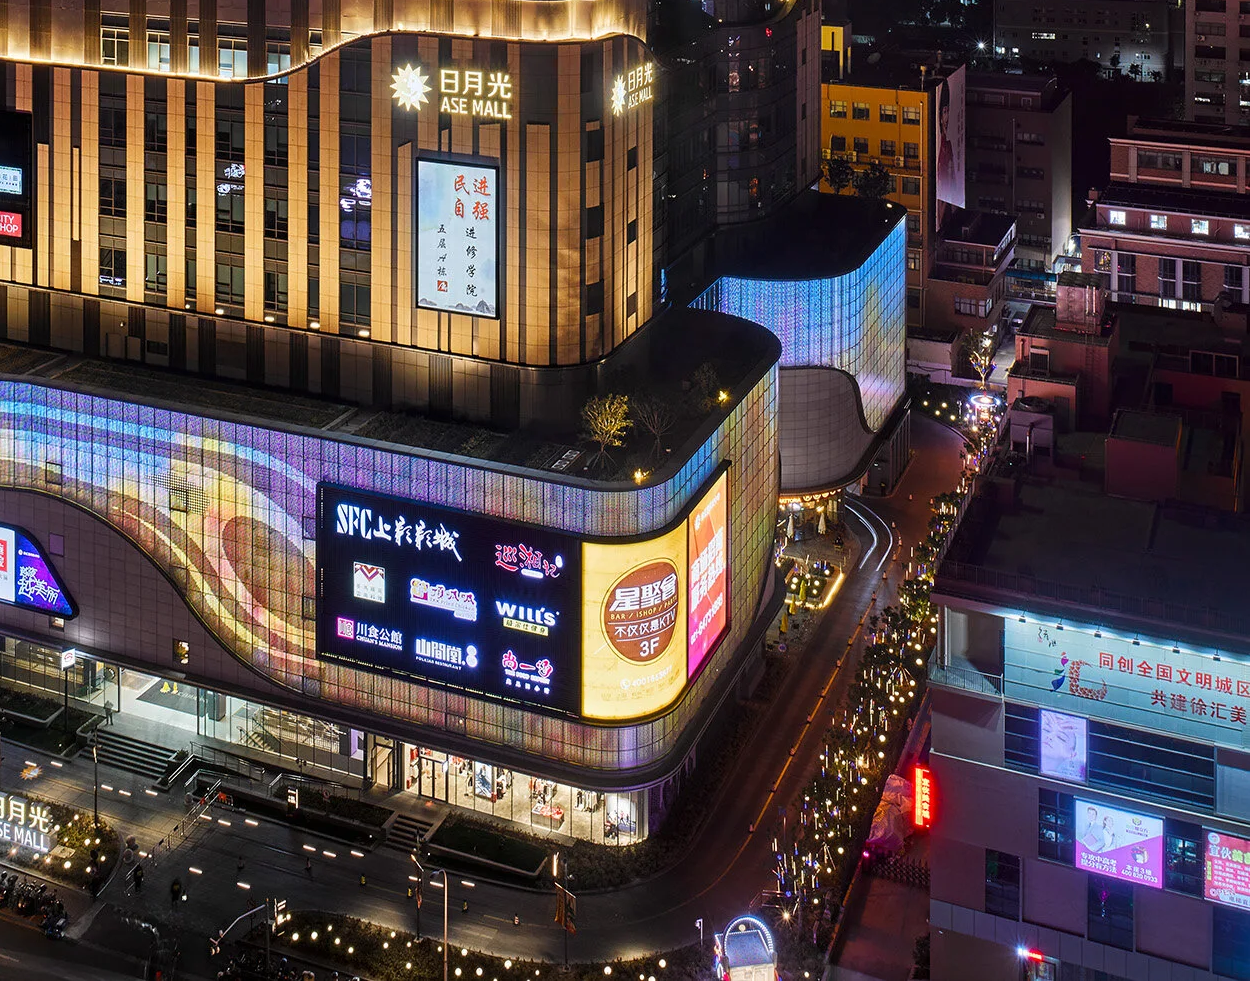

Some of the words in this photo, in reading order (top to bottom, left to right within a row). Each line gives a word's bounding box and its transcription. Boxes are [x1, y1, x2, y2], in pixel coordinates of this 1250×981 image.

[440, 69, 512, 99] 日月光
[628, 62, 653, 92] 日月光
[440, 96, 468, 115] ASE
[472, 99, 512, 119] MALL
[628, 92, 639, 109] ASE
[639, 85, 653, 105] MALL
[336, 504, 372, 539] SFC
[610, 612, 626, 620] BAR
[356, 621, 403, 645] 川食公館
[378, 640, 403, 651] MANSION
[639, 637, 660, 657] 3F
[1099, 652, 1250, 697] 同创全国文明城区
[1150, 690, 1248, 725] 共建徐汇美
[14, 826, 49, 853] MALL
